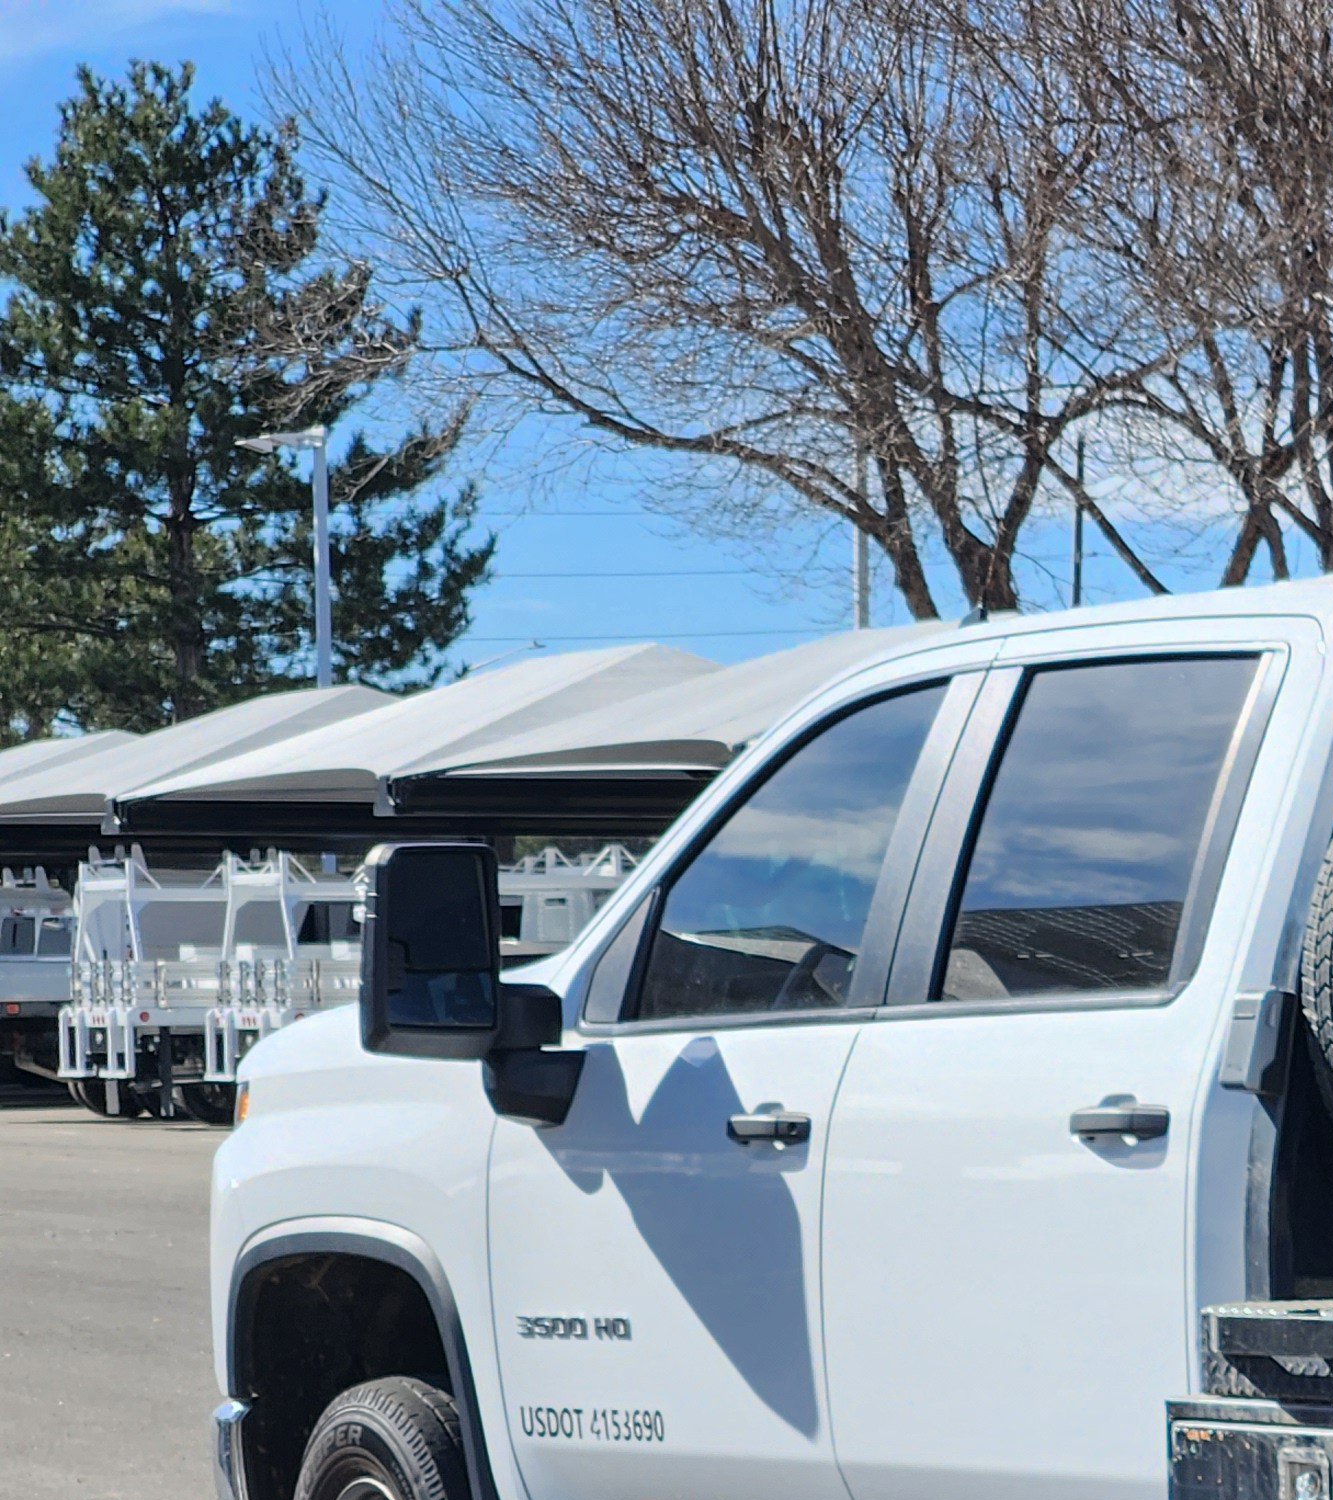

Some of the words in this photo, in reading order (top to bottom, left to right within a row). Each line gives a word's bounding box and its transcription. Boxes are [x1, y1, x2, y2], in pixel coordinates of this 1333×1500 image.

[516, 1316, 589, 1340] 3500
[594, 1317, 633, 1341] HD
[519, 1405, 584, 1440] USDOT
